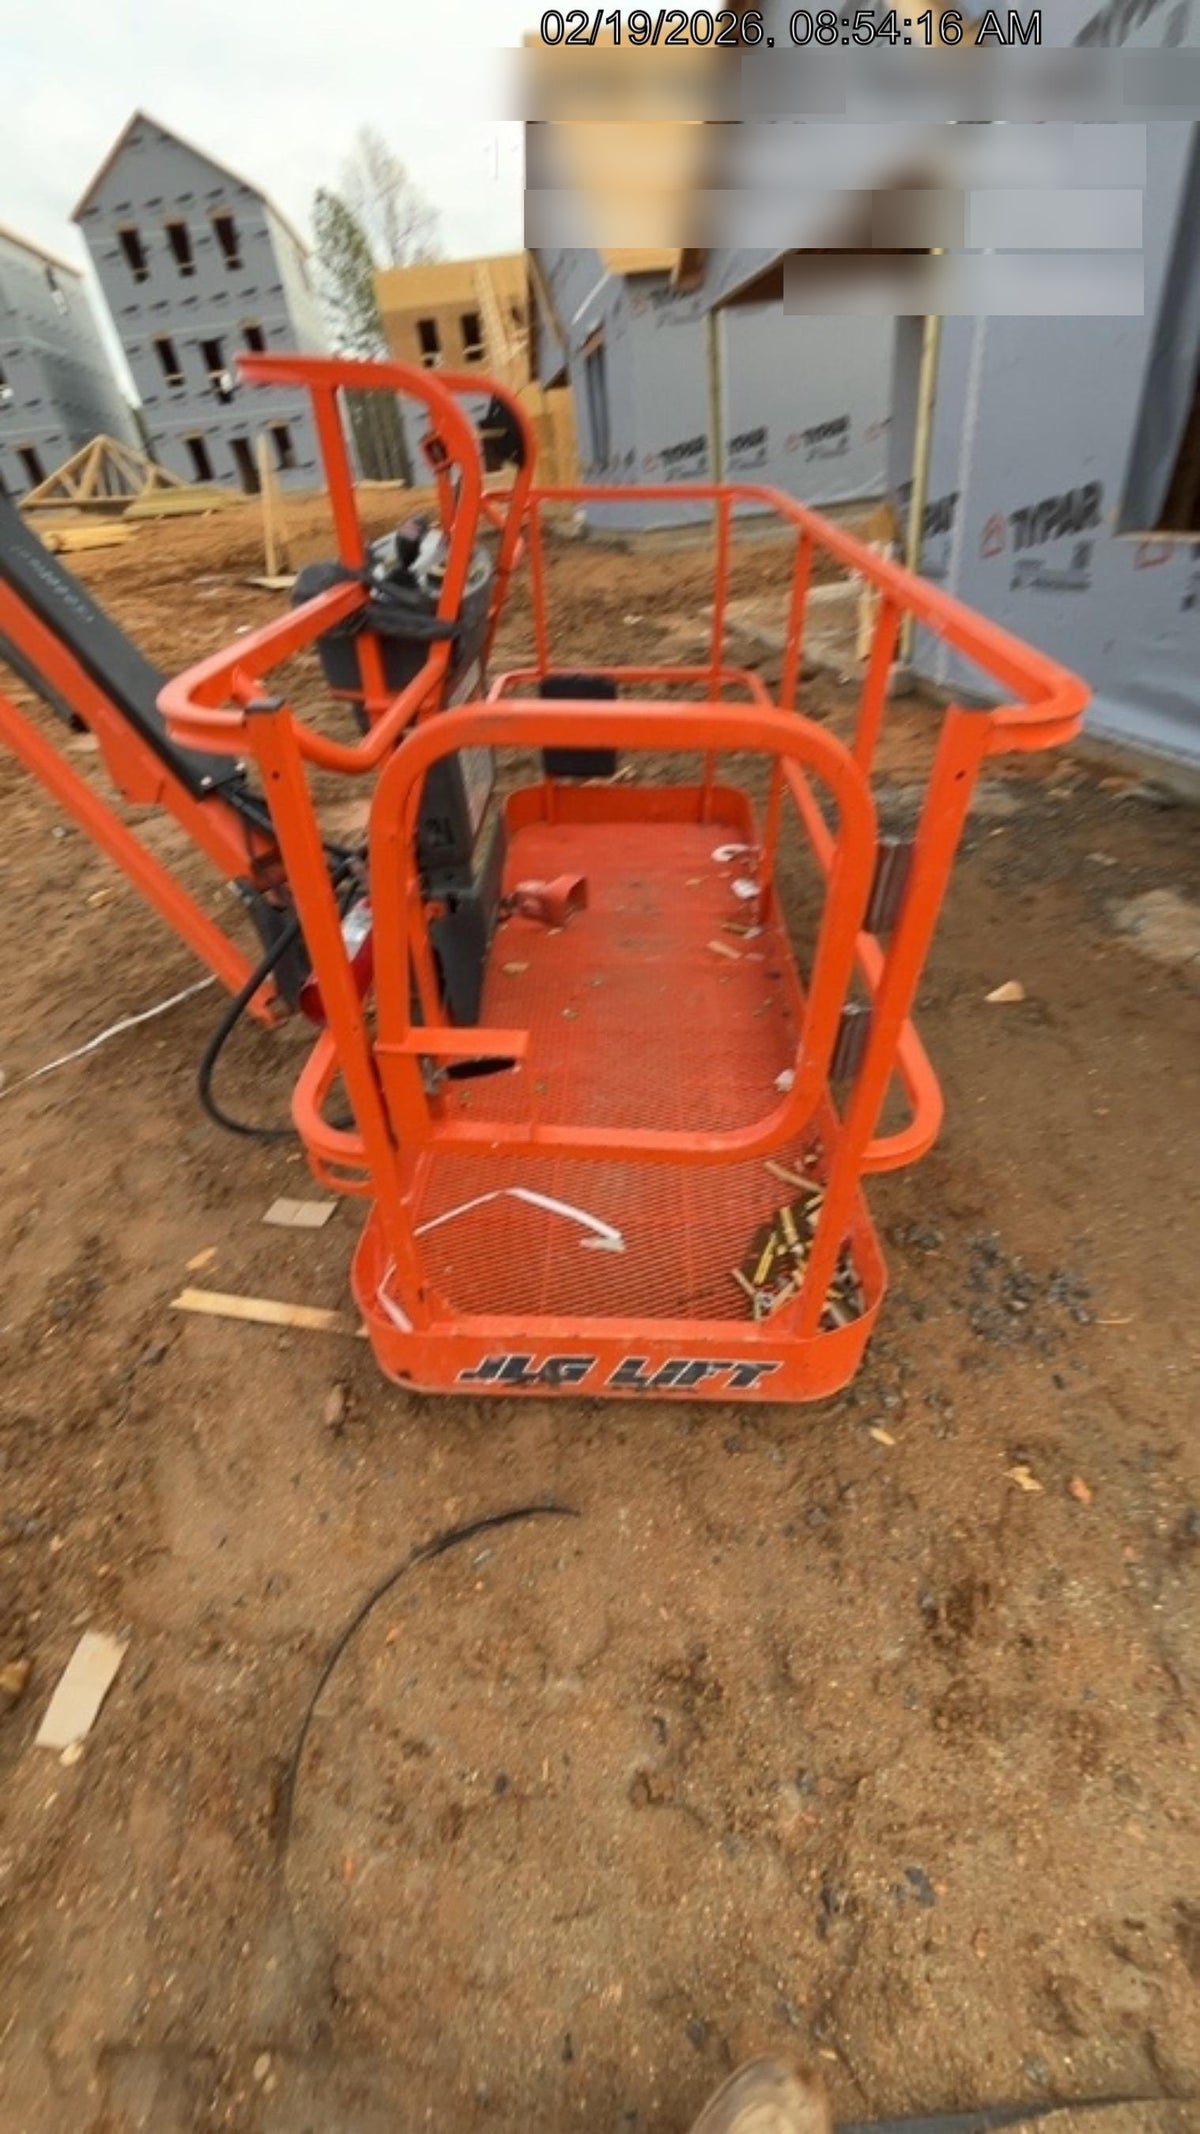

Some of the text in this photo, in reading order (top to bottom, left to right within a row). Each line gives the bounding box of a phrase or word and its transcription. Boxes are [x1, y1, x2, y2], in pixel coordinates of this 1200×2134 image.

[1008, 479, 1104, 552] TYPAR
[454, 1353, 784, 1390] JLG LIFT
